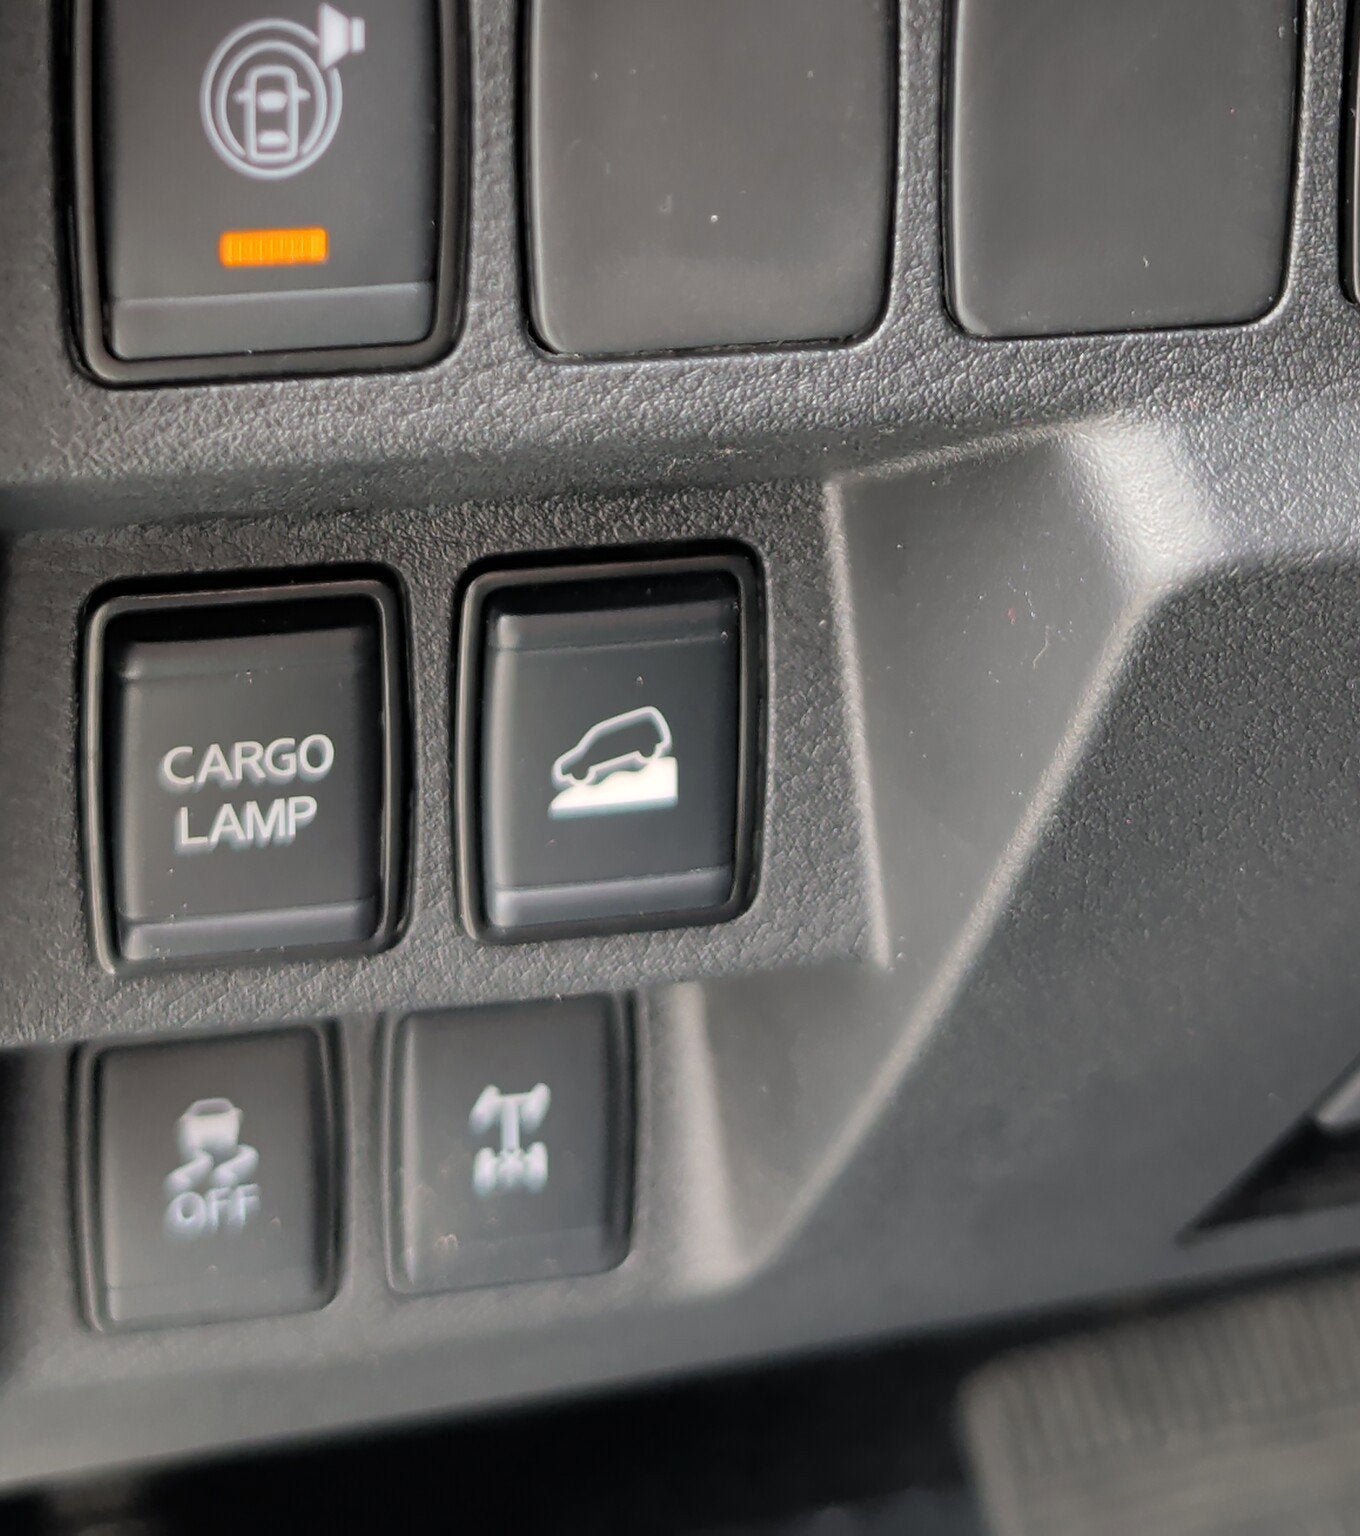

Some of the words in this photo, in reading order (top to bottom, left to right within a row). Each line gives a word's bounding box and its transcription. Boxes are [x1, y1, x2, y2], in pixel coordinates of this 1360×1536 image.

[160, 733, 335, 790] CARGO
[177, 795, 318, 852] LAMP
[165, 1183, 260, 1238] OFF
